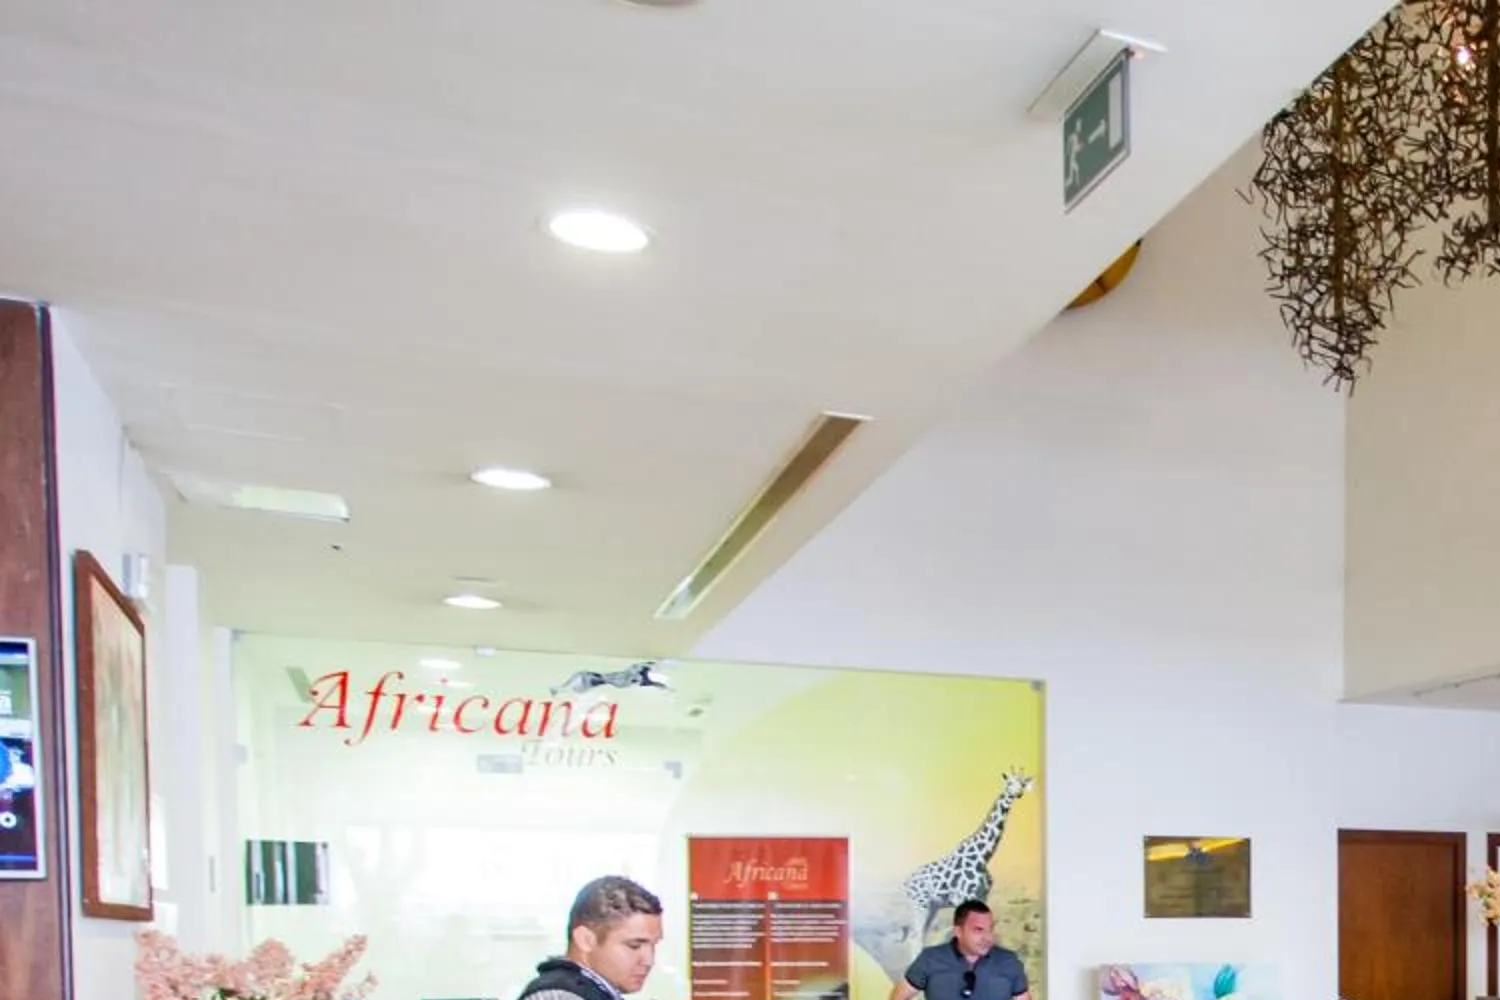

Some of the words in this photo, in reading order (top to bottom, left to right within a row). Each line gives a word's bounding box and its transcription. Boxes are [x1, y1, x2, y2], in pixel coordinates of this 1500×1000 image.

[297, 670, 619, 748] Africana
[522, 739, 619, 769] Tours
[724, 859, 809, 888] Africana
